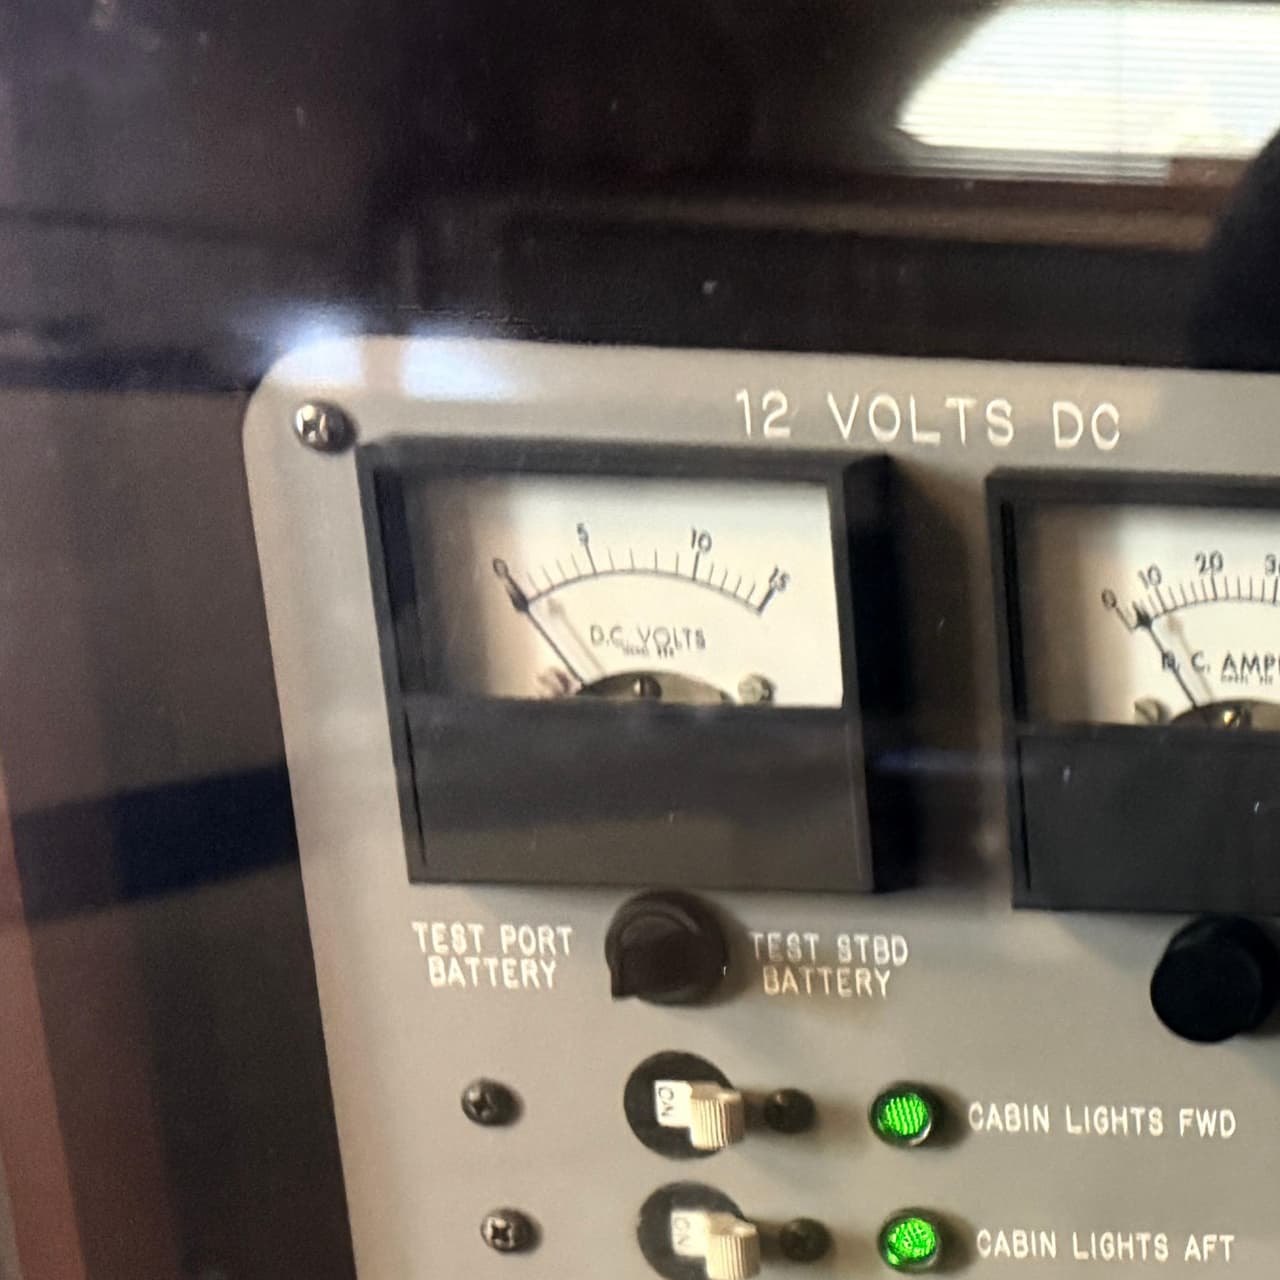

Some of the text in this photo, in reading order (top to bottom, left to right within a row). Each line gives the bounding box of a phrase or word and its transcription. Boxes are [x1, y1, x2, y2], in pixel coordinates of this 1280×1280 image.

[736, 389, 1121, 450] 12 VOLTS DC
[691, 528, 712, 551] 10
[1138, 565, 1162, 590] 10
[1196, 551, 1224, 574] 20
[1102, 589, 1117, 610] 0
[1191, 652, 1212, 673] C.
[412, 921, 574, 958] TEST PORT
[750, 932, 909, 966] TEST STBD
[428, 956, 557, 990] BATTERY
[763, 967, 891, 998] BATTERY
[968, 1102, 1237, 1138] CABIN LIGHTS FWD
[976, 1229, 1235, 1261] CABIN LIGHTS AFT
